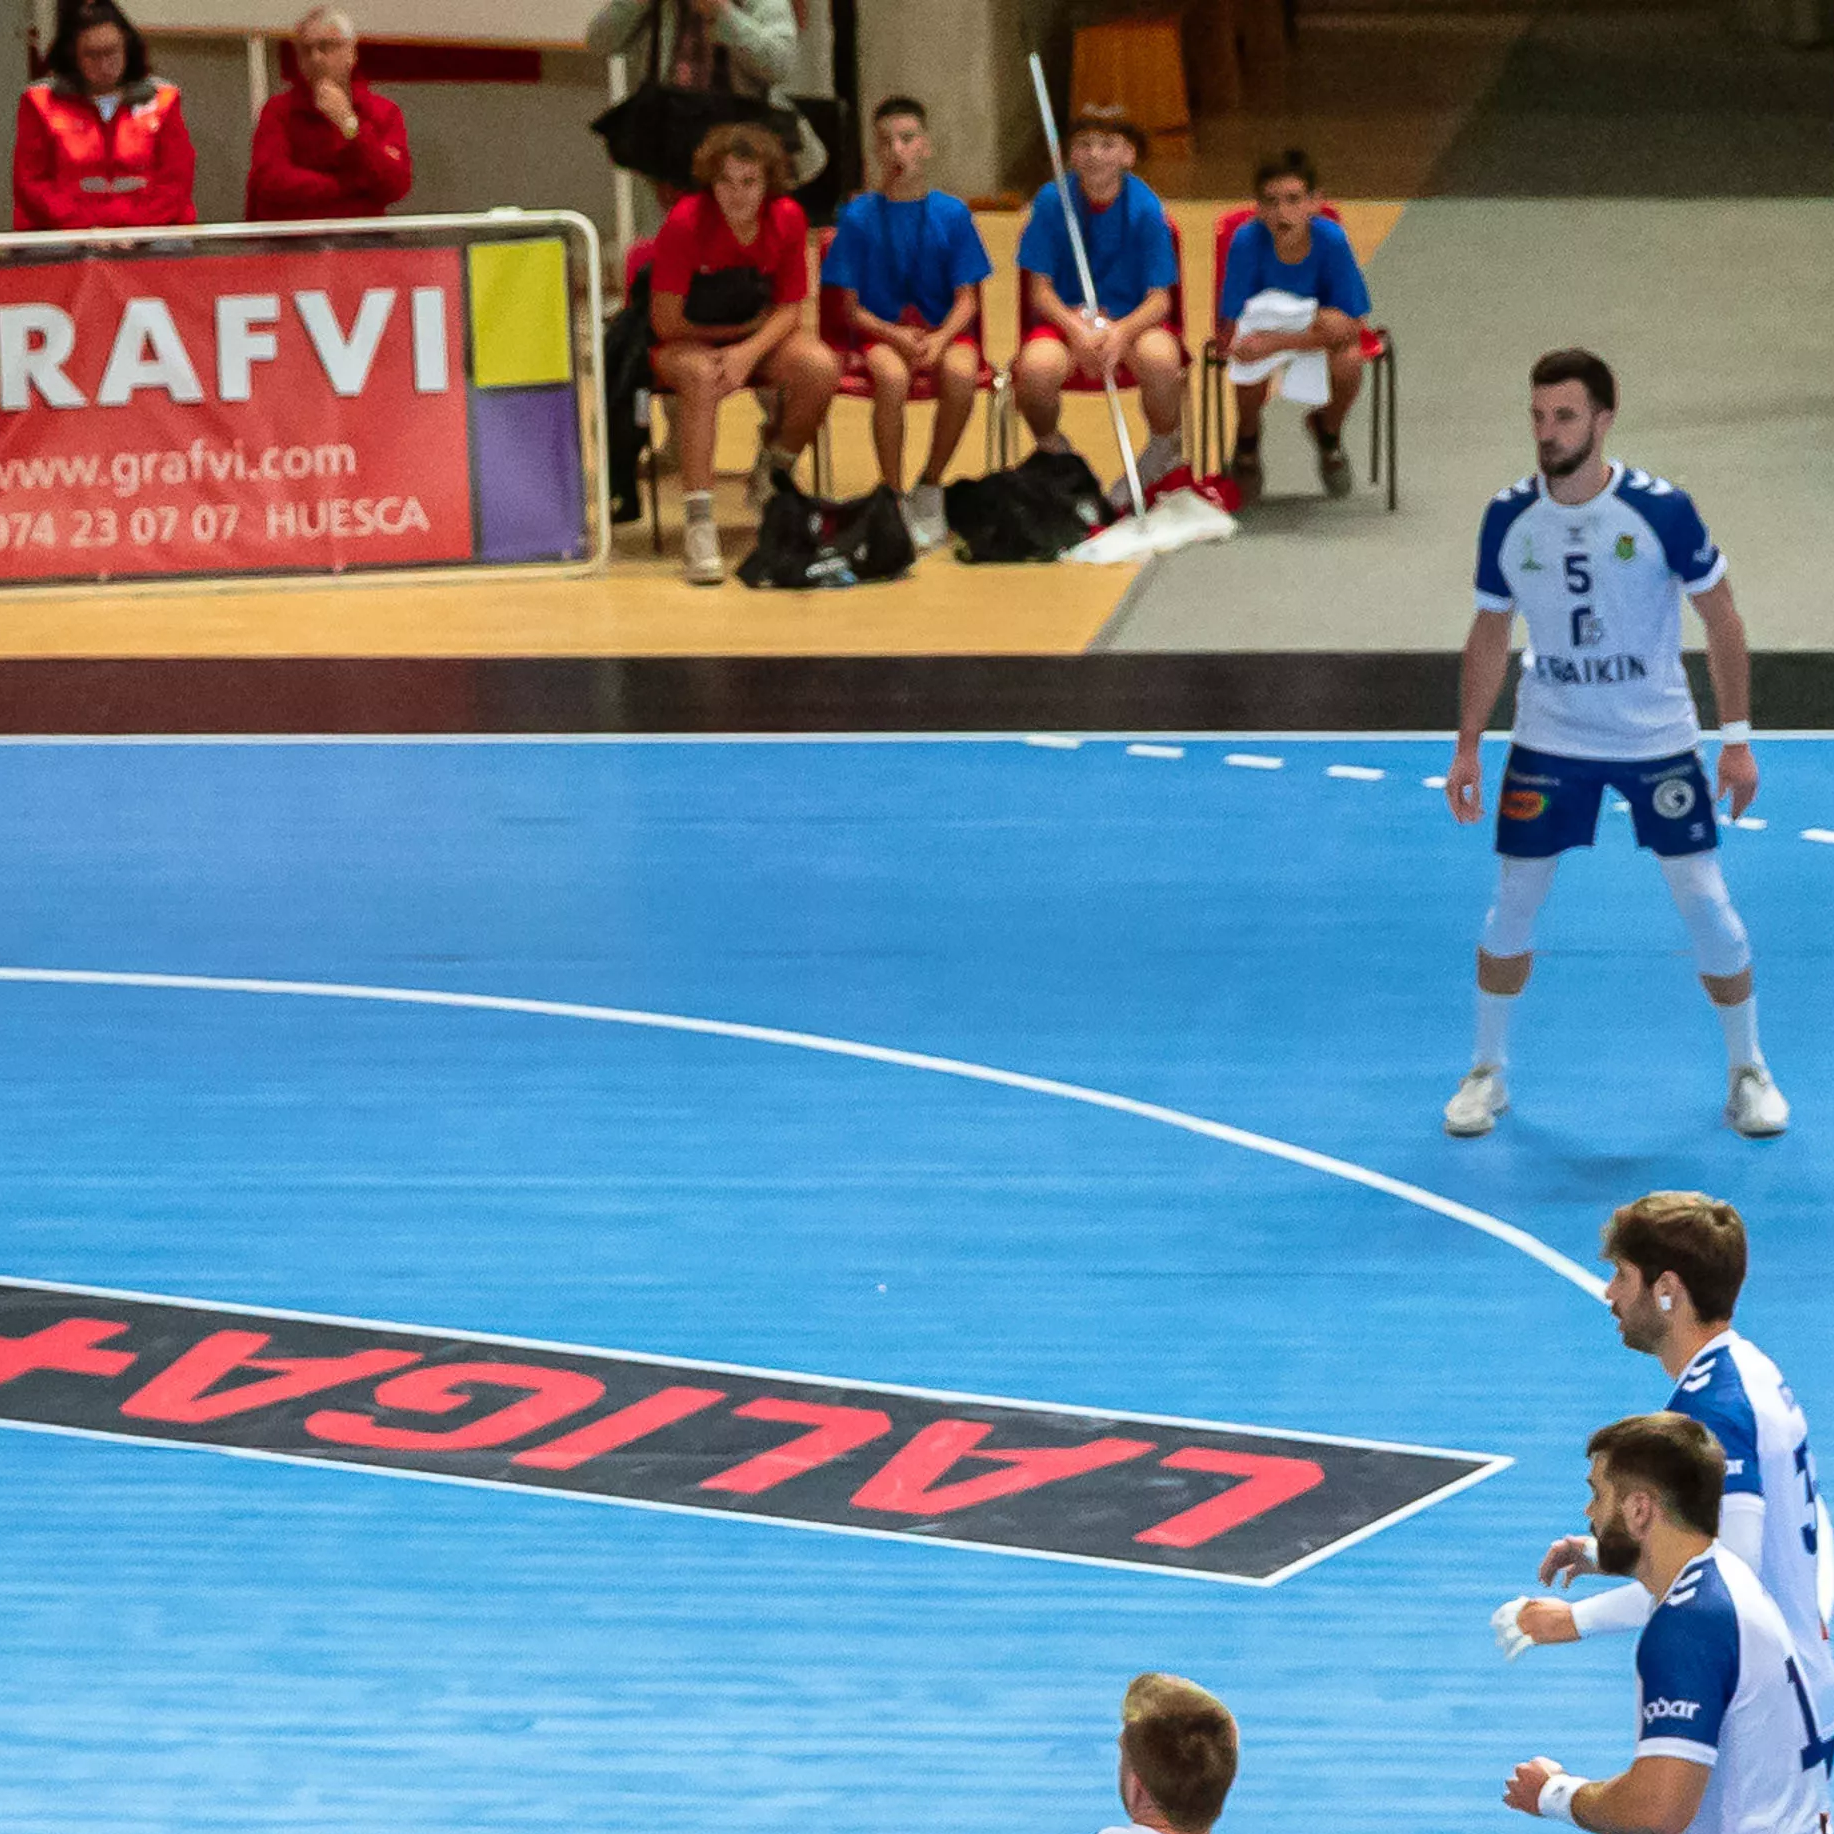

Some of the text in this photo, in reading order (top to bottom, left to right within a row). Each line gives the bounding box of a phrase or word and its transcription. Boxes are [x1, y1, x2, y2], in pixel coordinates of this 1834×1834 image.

[69, 509, 118, 548] 23
[129, 505, 178, 546] 07
[191, 504, 239, 542] 07
[266, 496, 430, 541] HUESCA
[1564, 553, 1592, 595] 5
[1535, 653, 1648, 685] FRAIKIN
